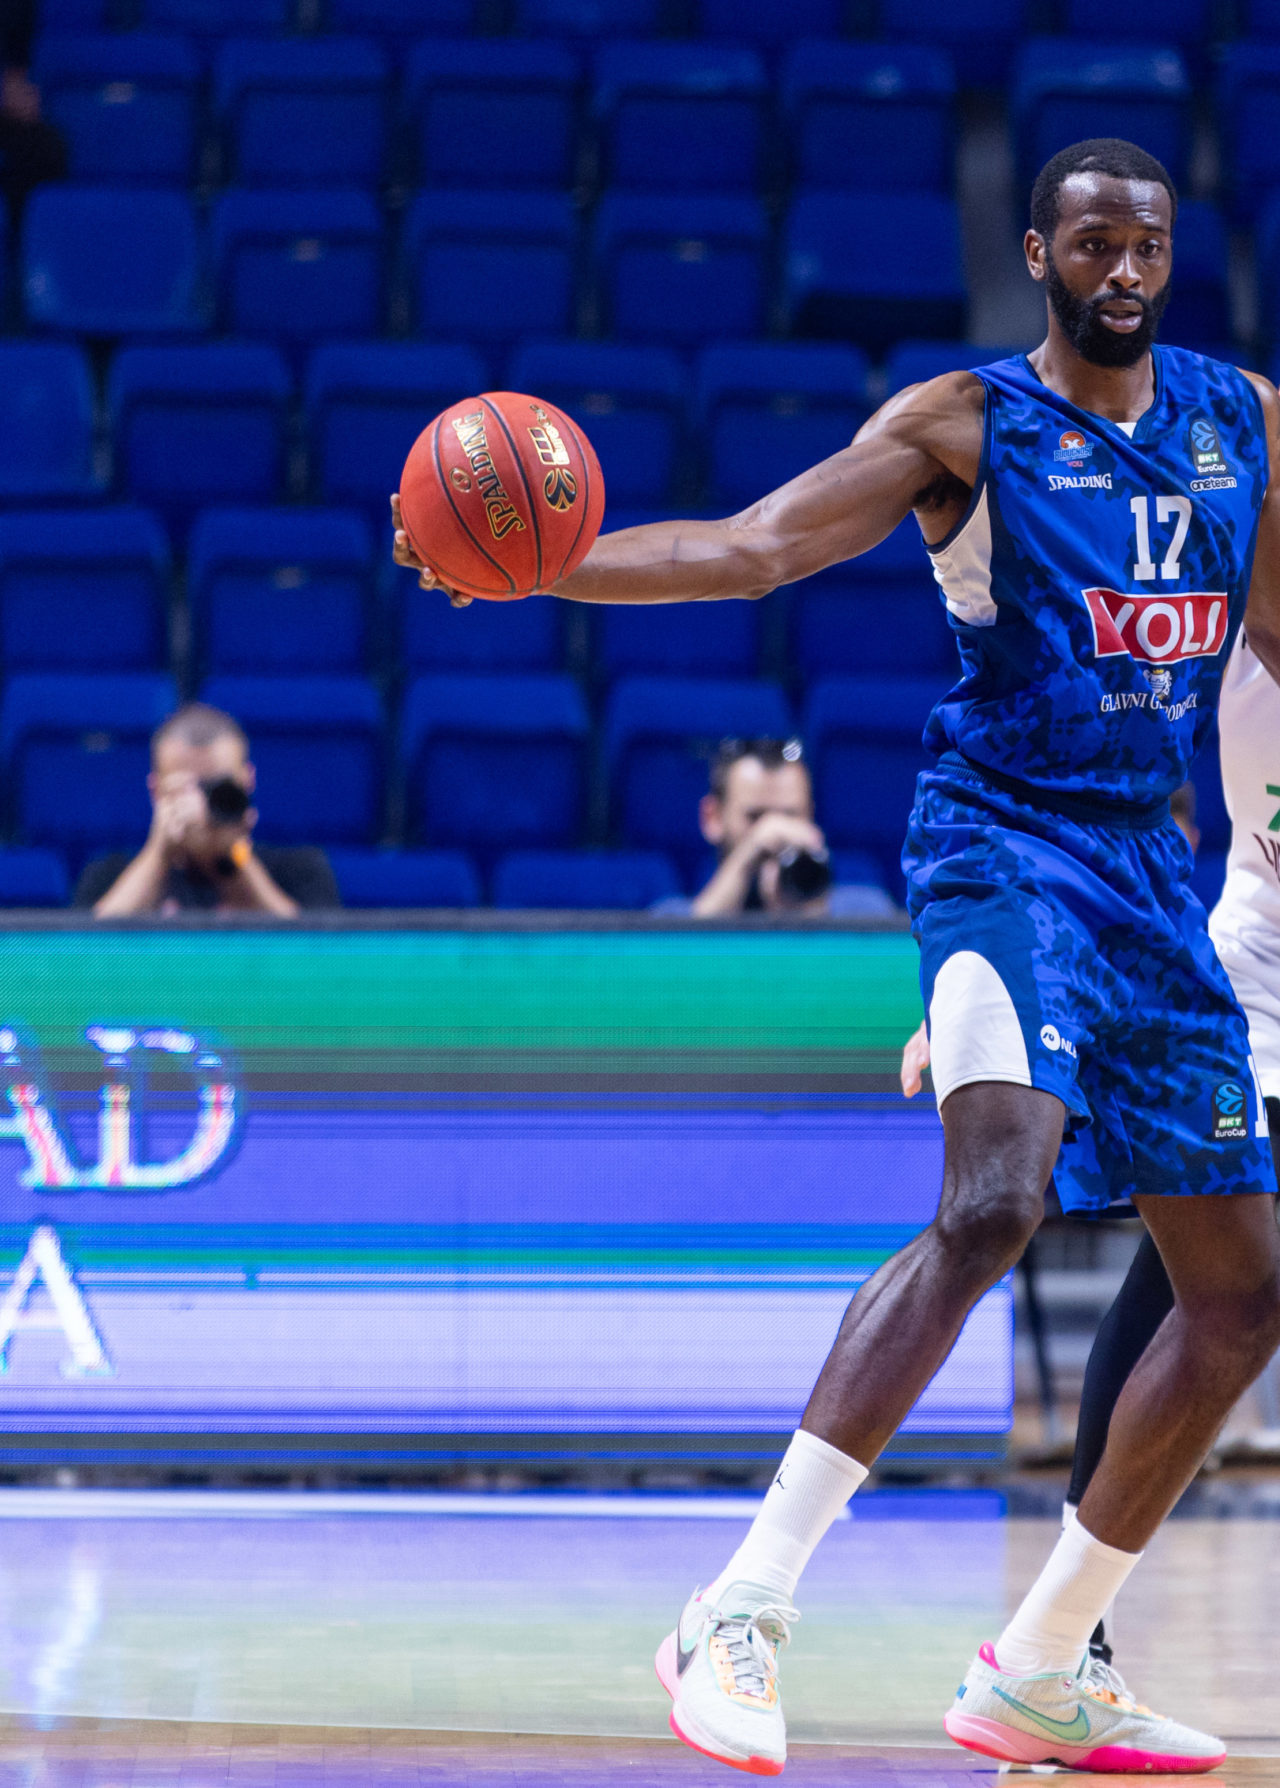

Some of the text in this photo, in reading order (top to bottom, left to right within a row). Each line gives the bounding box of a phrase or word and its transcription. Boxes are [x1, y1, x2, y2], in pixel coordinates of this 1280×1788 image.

[1198, 452, 1219, 464] BKT
[452, 410, 527, 540] SPALDING
[1197, 463, 1227, 473] EuroCup
[1047, 473, 1113, 491] SPALDING
[1190, 477, 1237, 492] oneteam
[1130, 495, 1192, 581] 17
[1100, 692, 1148, 713] GLAVNI
[1218, 1116, 1242, 1129] BKT
[1215, 1128, 1247, 1138] EuroCup
